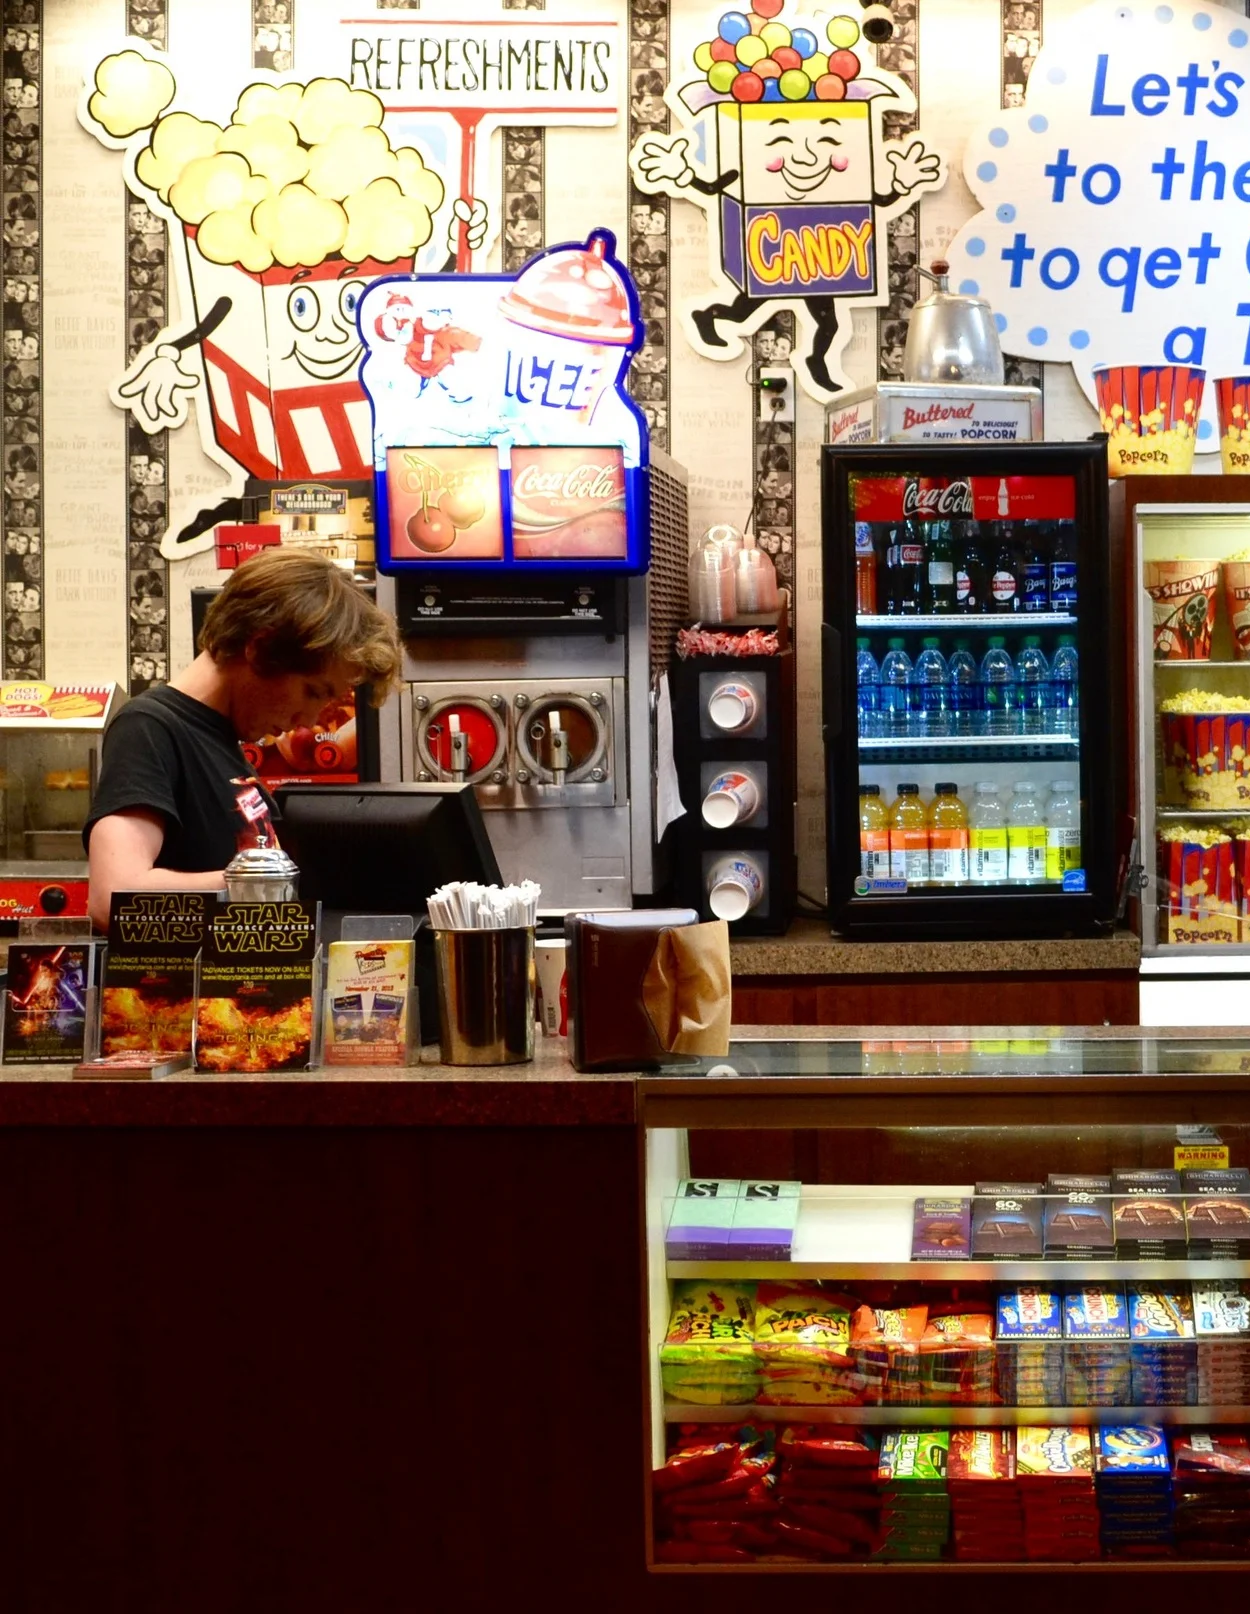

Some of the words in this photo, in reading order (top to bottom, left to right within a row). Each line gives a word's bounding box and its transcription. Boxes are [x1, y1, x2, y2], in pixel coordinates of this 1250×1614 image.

[350, 37, 611, 94] REFRESHMENTS
[1090, 54, 1245, 118] Let's
[1044, 149, 1121, 205] to
[747, 212, 873, 286] CANDY
[1001, 233, 1079, 291] to
[1163, 326, 1206, 366] a
[902, 402, 975, 430] Buttered
[960, 428, 1017, 440] POPCORN
[1118, 449, 1169, 465] Popcorn
[513, 464, 619, 500] Coca-Cola
[902, 480, 973, 517] Coca-Cola
[12, 905, 34, 914] Hut
[120, 894, 205, 916] STAR
[214, 904, 310, 925] STAR
[120, 922, 205, 943] WARS
[214, 932, 309, 952] WARS
[1172, 928, 1233, 942] Popcorn
[1178, 1152, 1225, 1160] WARNING
[1021, 1286, 1038, 1322] CRUNCH
[1085, 1287, 1104, 1322] CRUNCH
[897, 1450, 914, 1476] Mike
